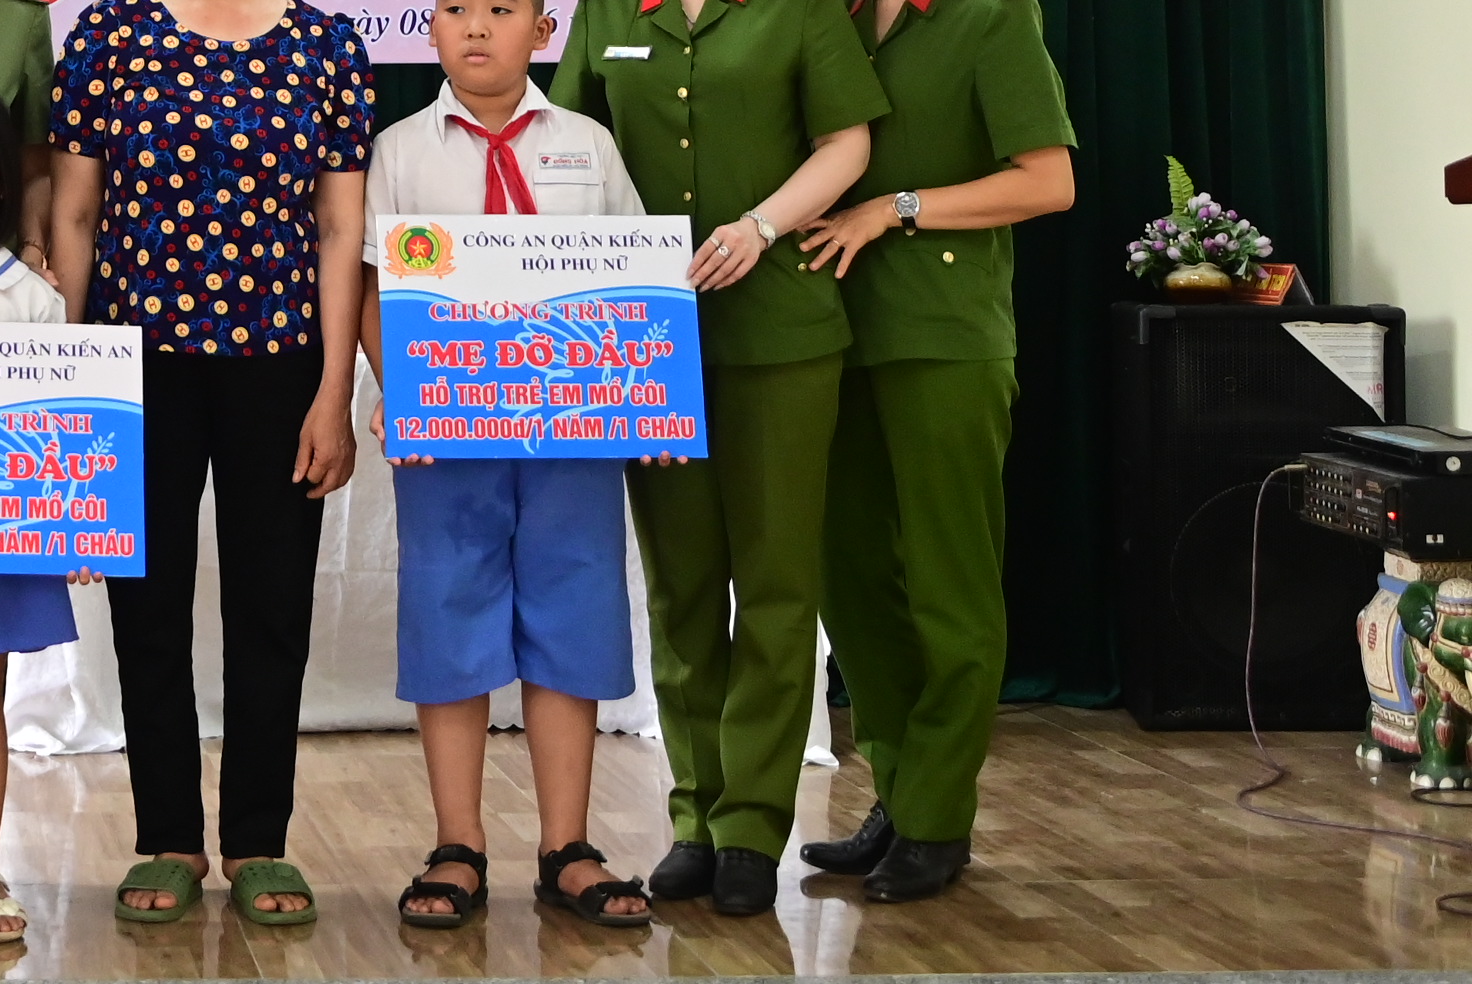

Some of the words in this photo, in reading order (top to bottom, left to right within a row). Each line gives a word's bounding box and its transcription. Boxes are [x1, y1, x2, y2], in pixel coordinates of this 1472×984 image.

[462, 229, 516, 248] CÔNG
[521, 234, 546, 248] AN
[551, 230, 604, 251] QUẬN
[608, 228, 654, 248] KIẾN
[658, 235, 683, 248] AN
[521, 253, 556, 274] HỘI
[561, 258, 598, 275] PHỤ
[602, 254, 629, 271] NỮ
[429, 300, 552, 321] CHƯƠNG
[558, 298, 648, 322] TRÌNH
[57, 338, 103, 358] KIẾN
[107, 345, 133, 359] AN
[496, 333, 553, 368] ĐỠ
[7, 366, 45, 383] PHỤ
[50, 365, 76, 381] NỮ
[420, 376, 451, 406] HỖ
[455, 381, 497, 409] TRỢ
[503, 377, 542, 406] TRẺ
[549, 383, 583, 406] EM
[589, 377, 624, 406] MỒ
[630, 378, 666, 406] CÔI
[0, 407, 93, 434] TRÌNH
[552, 413, 604, 440] NĂM
[608, 416, 628, 440] /1
[636, 411, 696, 439] CHÁU
[28, 490, 63, 521] MỒ
[70, 492, 107, 521] CÔI
[45, 532, 67, 555] /1
[74, 527, 135, 557] CHÁU
